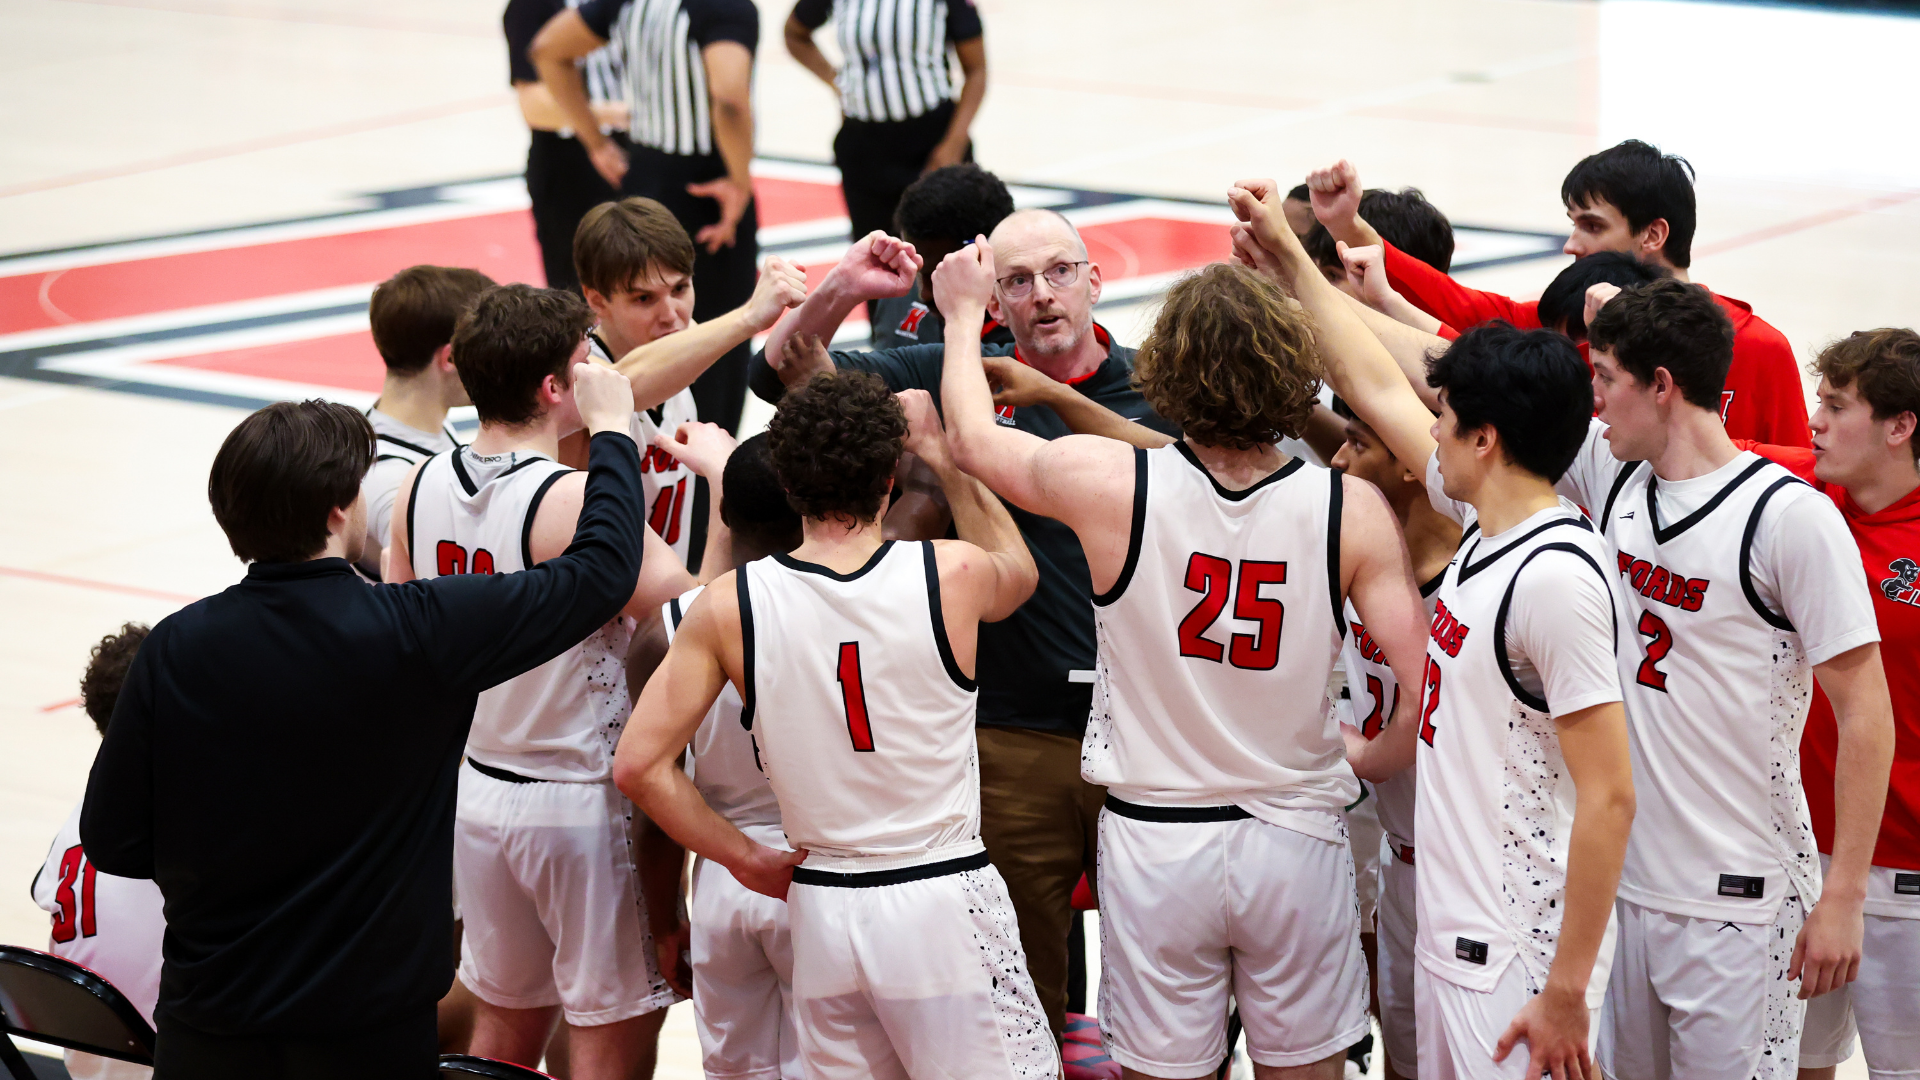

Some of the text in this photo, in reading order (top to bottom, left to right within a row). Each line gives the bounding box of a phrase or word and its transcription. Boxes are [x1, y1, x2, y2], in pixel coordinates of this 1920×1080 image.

[1178, 551, 1287, 671] 25
[1617, 549, 1710, 612] FORDS
[837, 641, 875, 752] 1
[1636, 609, 1673, 693] 2
[52, 843, 97, 944] 31
[1752, 883, 1757, 892] L
